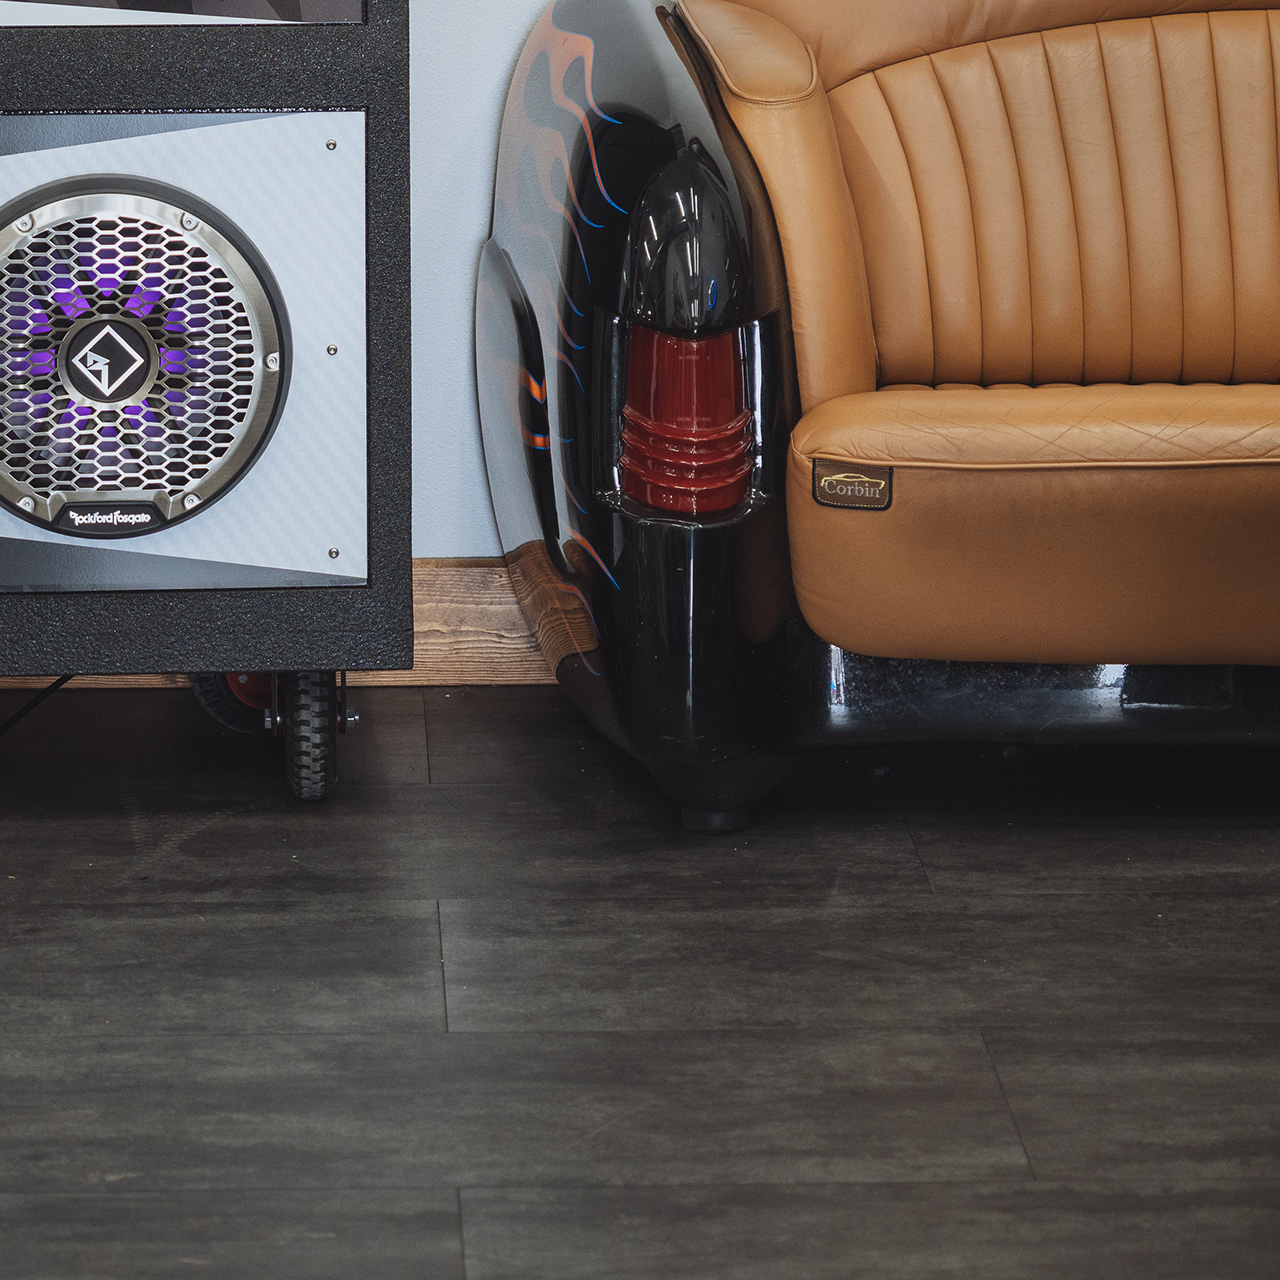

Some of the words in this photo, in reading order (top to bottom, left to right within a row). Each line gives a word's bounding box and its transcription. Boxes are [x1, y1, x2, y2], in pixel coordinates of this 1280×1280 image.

[824, 479, 880, 498] Corbin
[69, 511, 113, 525] Rockford
[113, 511, 151, 525] Fosgate
